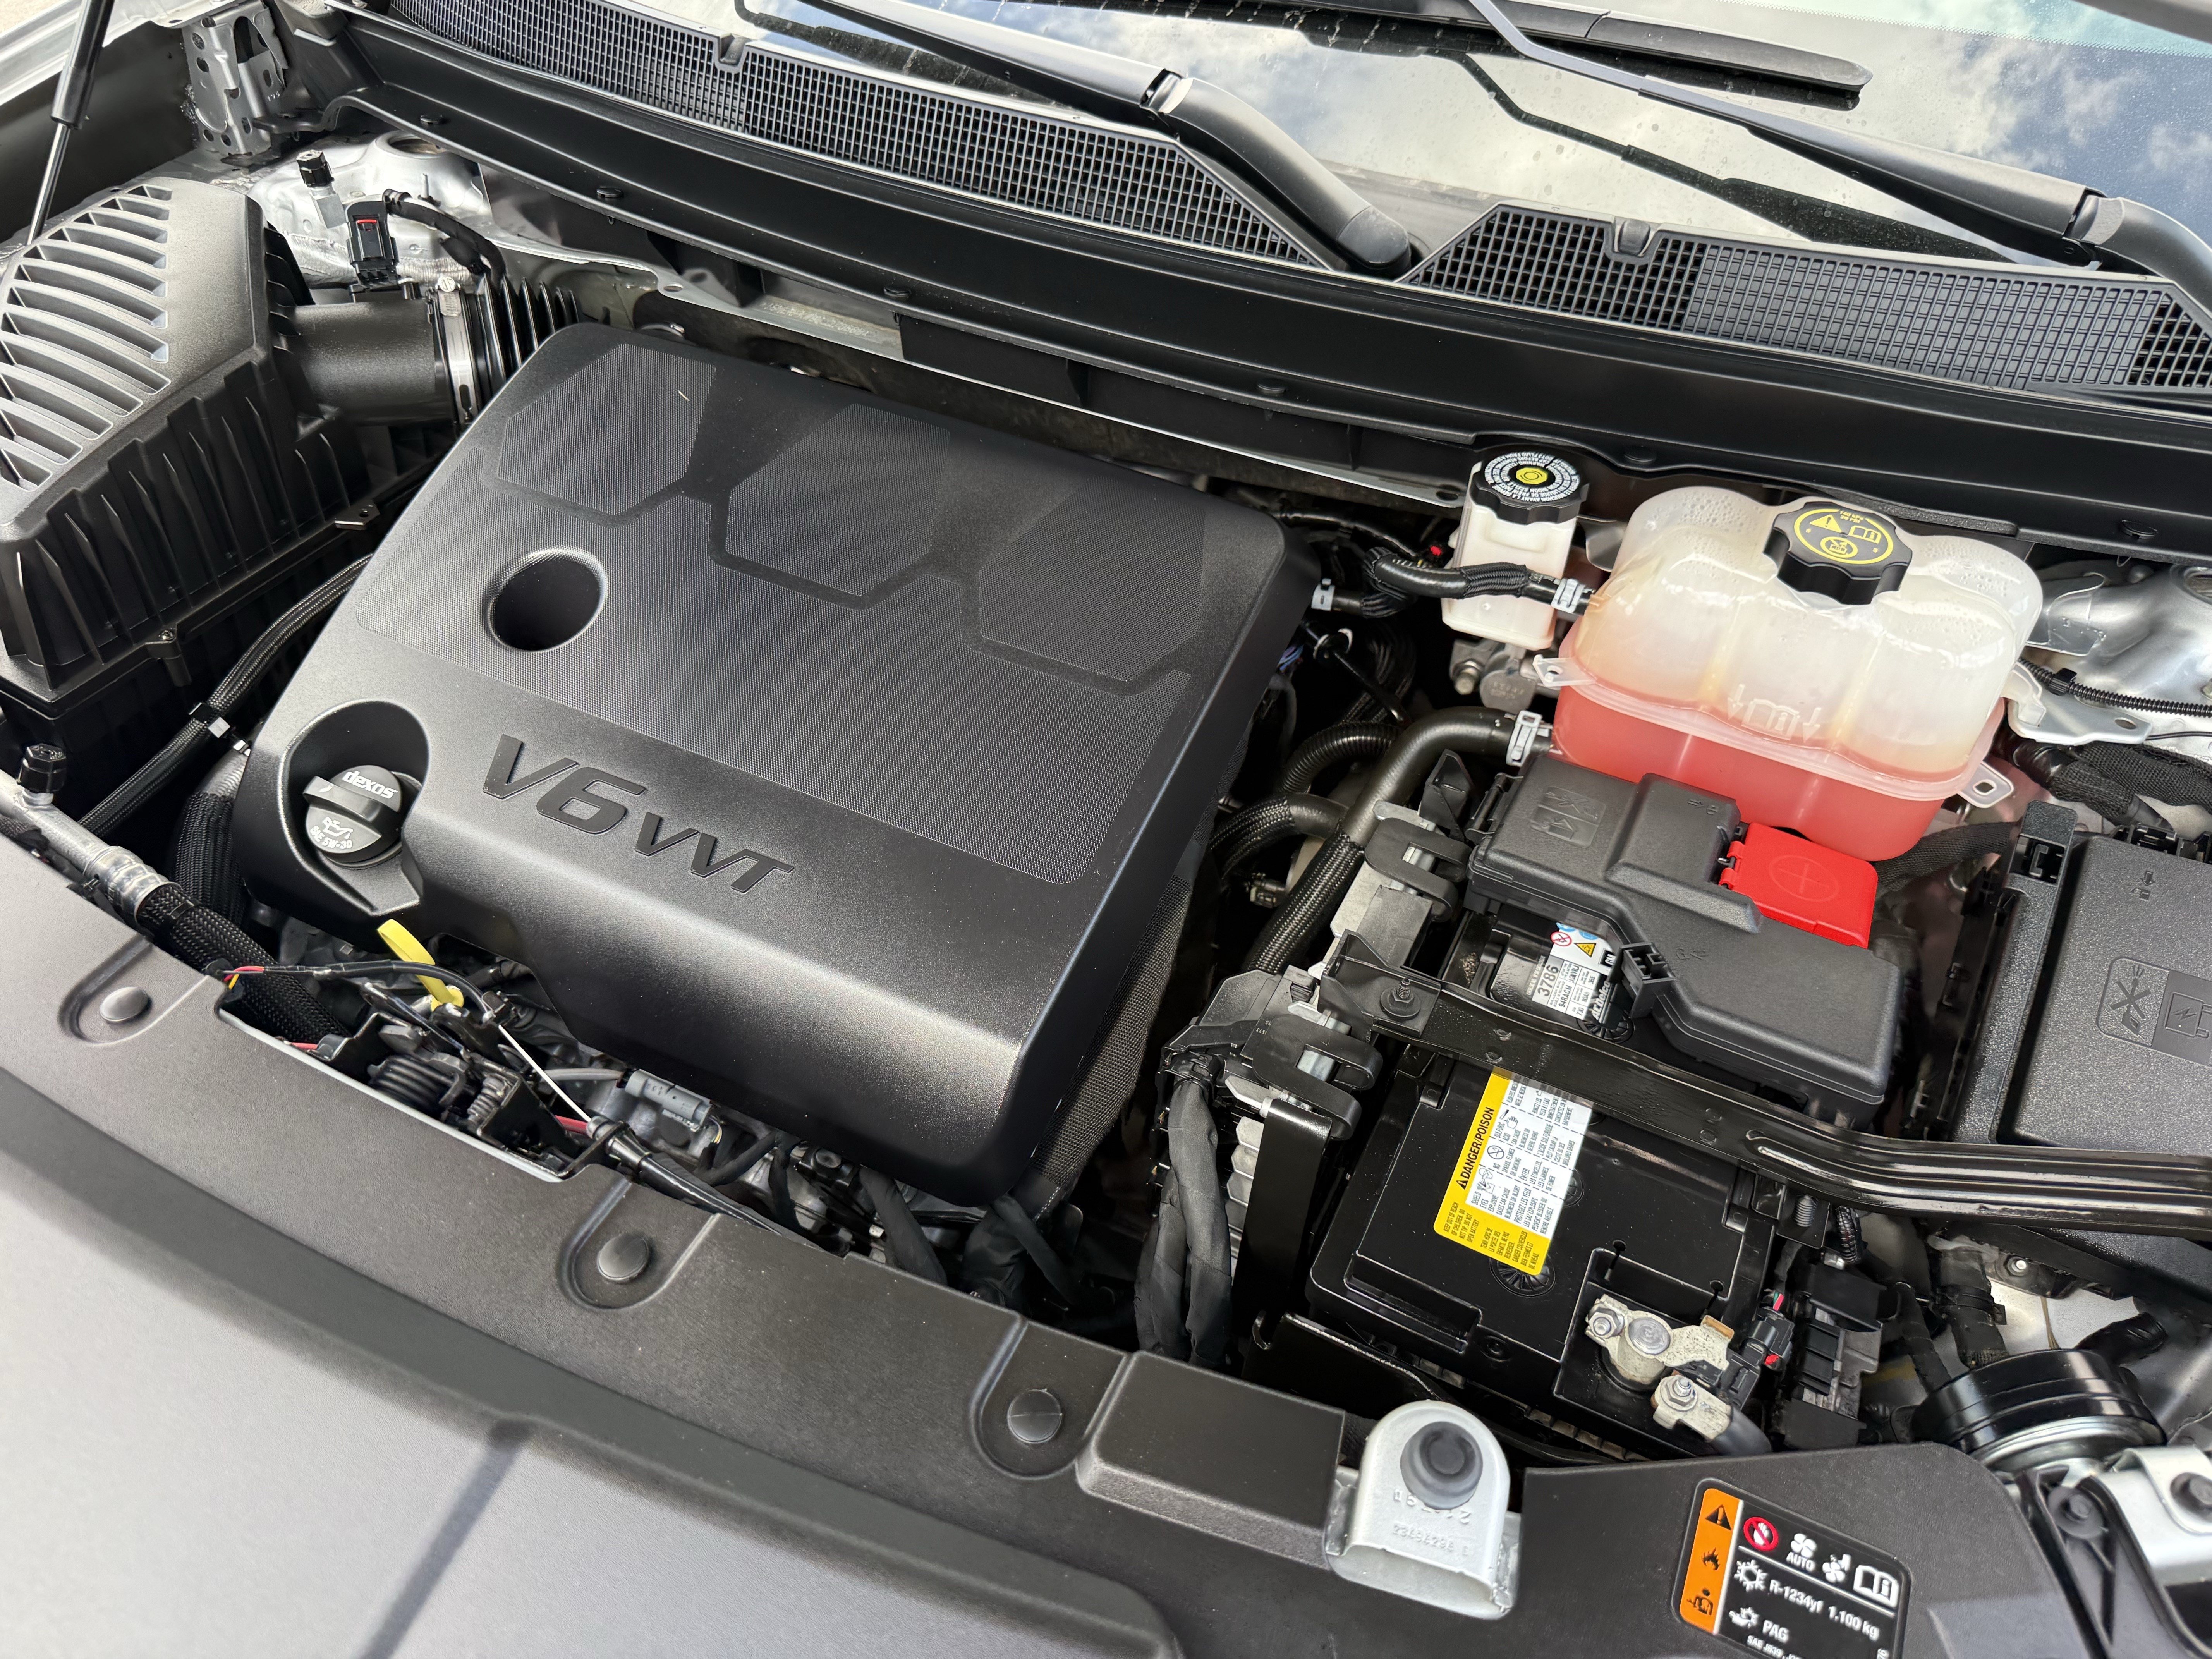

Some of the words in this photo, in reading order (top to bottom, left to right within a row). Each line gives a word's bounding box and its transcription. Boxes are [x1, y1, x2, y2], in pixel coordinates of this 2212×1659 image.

[342, 770, 398, 799] dexos
[482, 733, 647, 835] V6
[635, 811, 795, 893] VVT
[310, 826, 325, 843] SAE
[322, 836, 353, 849] 5W-30
[1605, 954, 1616, 965] GM
[1537, 965, 1559, 996] 3786
[1558, 984, 1572, 1007] 94RAGM
[1591, 981, 1610, 1020] ACDelco
[1576, 1007, 1584, 1016] 730
[1460, 1107, 1494, 1179] DANGER/POISON
[1786, 1553, 1816, 1571] AUTO
[1769, 1579, 1824, 1614] R-1234yf
[1828, 1605, 1862, 1631] 1.100
[1862, 1618, 1881, 1641] kg
[1747, 1635, 1765, 1652] SAE
[1762, 1620, 1790, 1644] PAG
